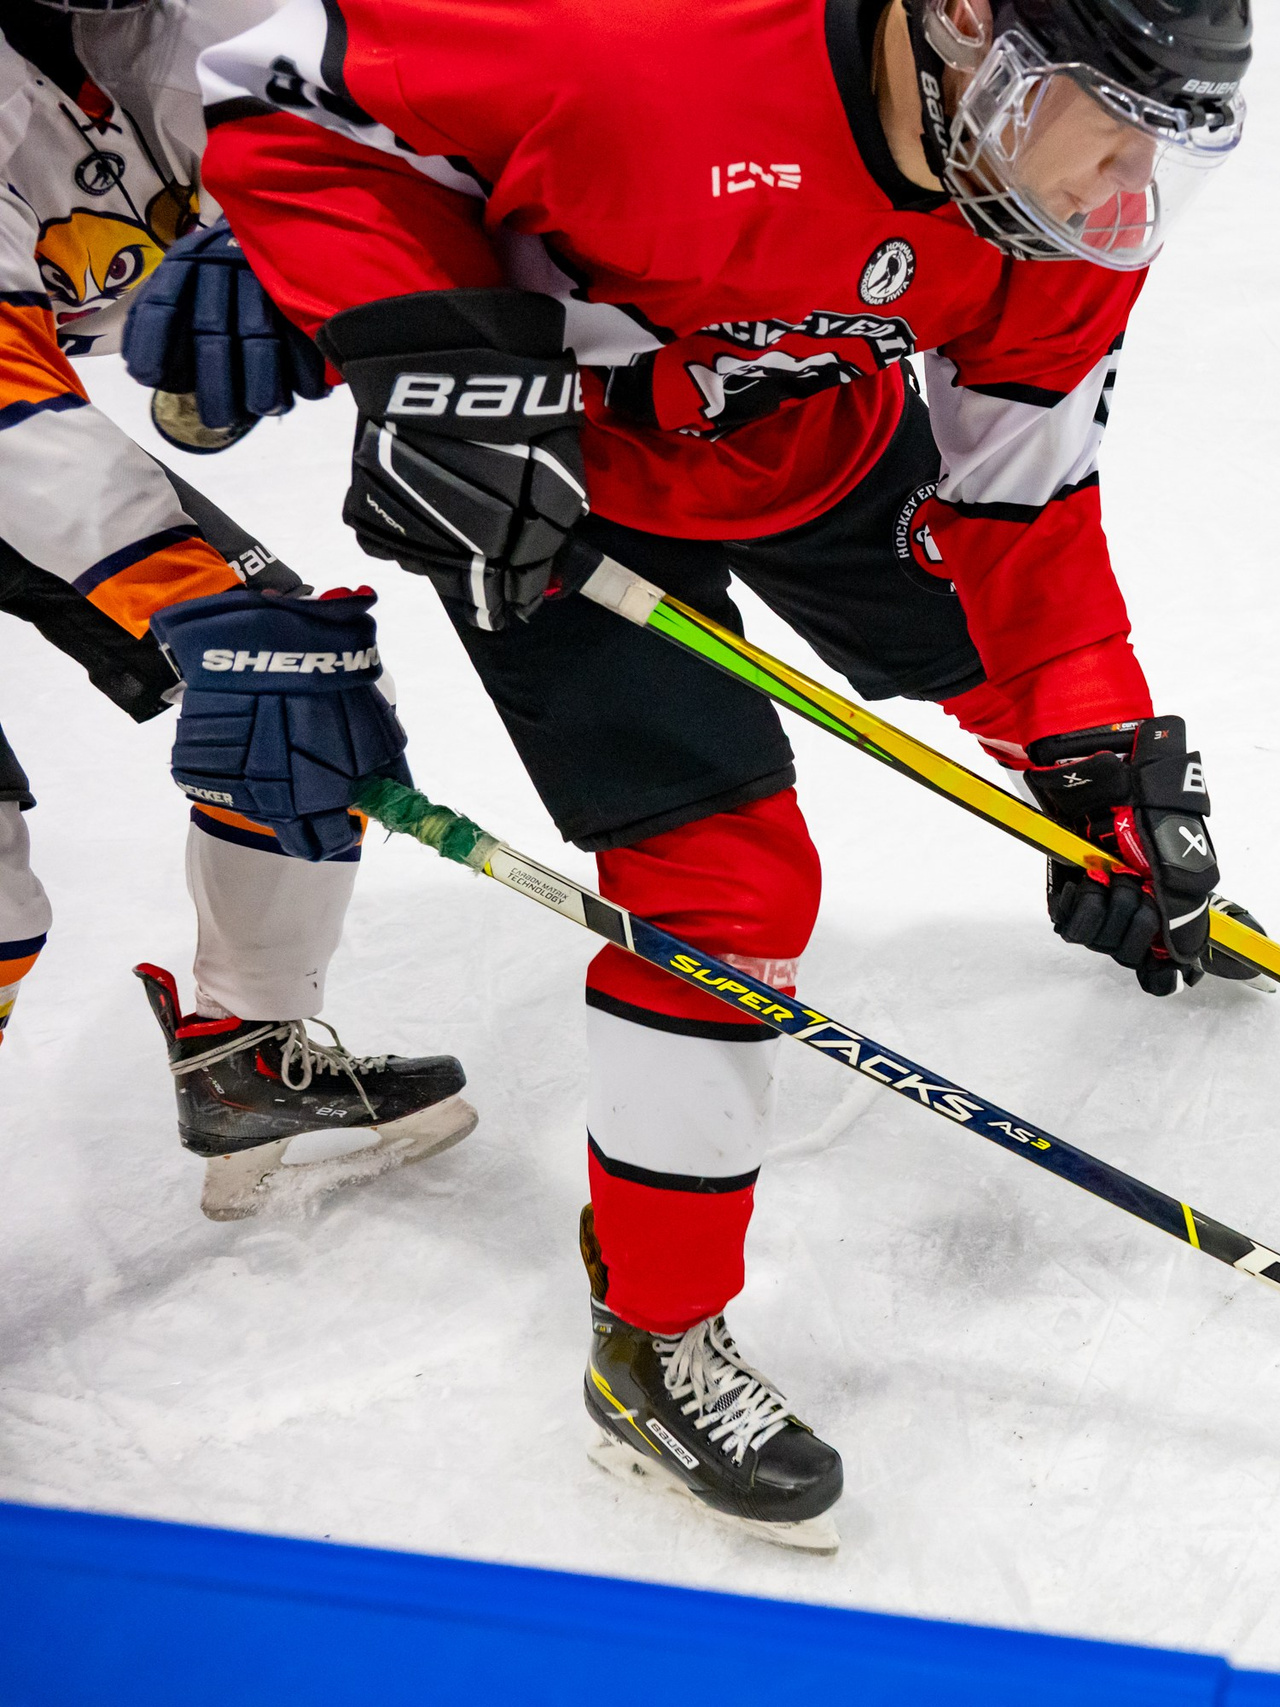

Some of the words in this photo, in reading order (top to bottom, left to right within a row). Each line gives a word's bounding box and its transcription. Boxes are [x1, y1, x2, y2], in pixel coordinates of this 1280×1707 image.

[921, 70, 949, 160] BAU
[366, 493, 406, 536] VAPOR
[896, 496, 918, 559] HOCKEY
[916, 482, 939, 501] ED
[506, 872, 566, 906] TECHNOLOGY
[510, 867, 541, 887] CARBON
[531, 882, 569, 900] MATRIX
[669, 953, 795, 1024] SUPER
[789, 1009, 985, 1123] TACKS
[987, 1120, 1052, 1151] AS3
[649, 1422, 693, 1466] BAUER
